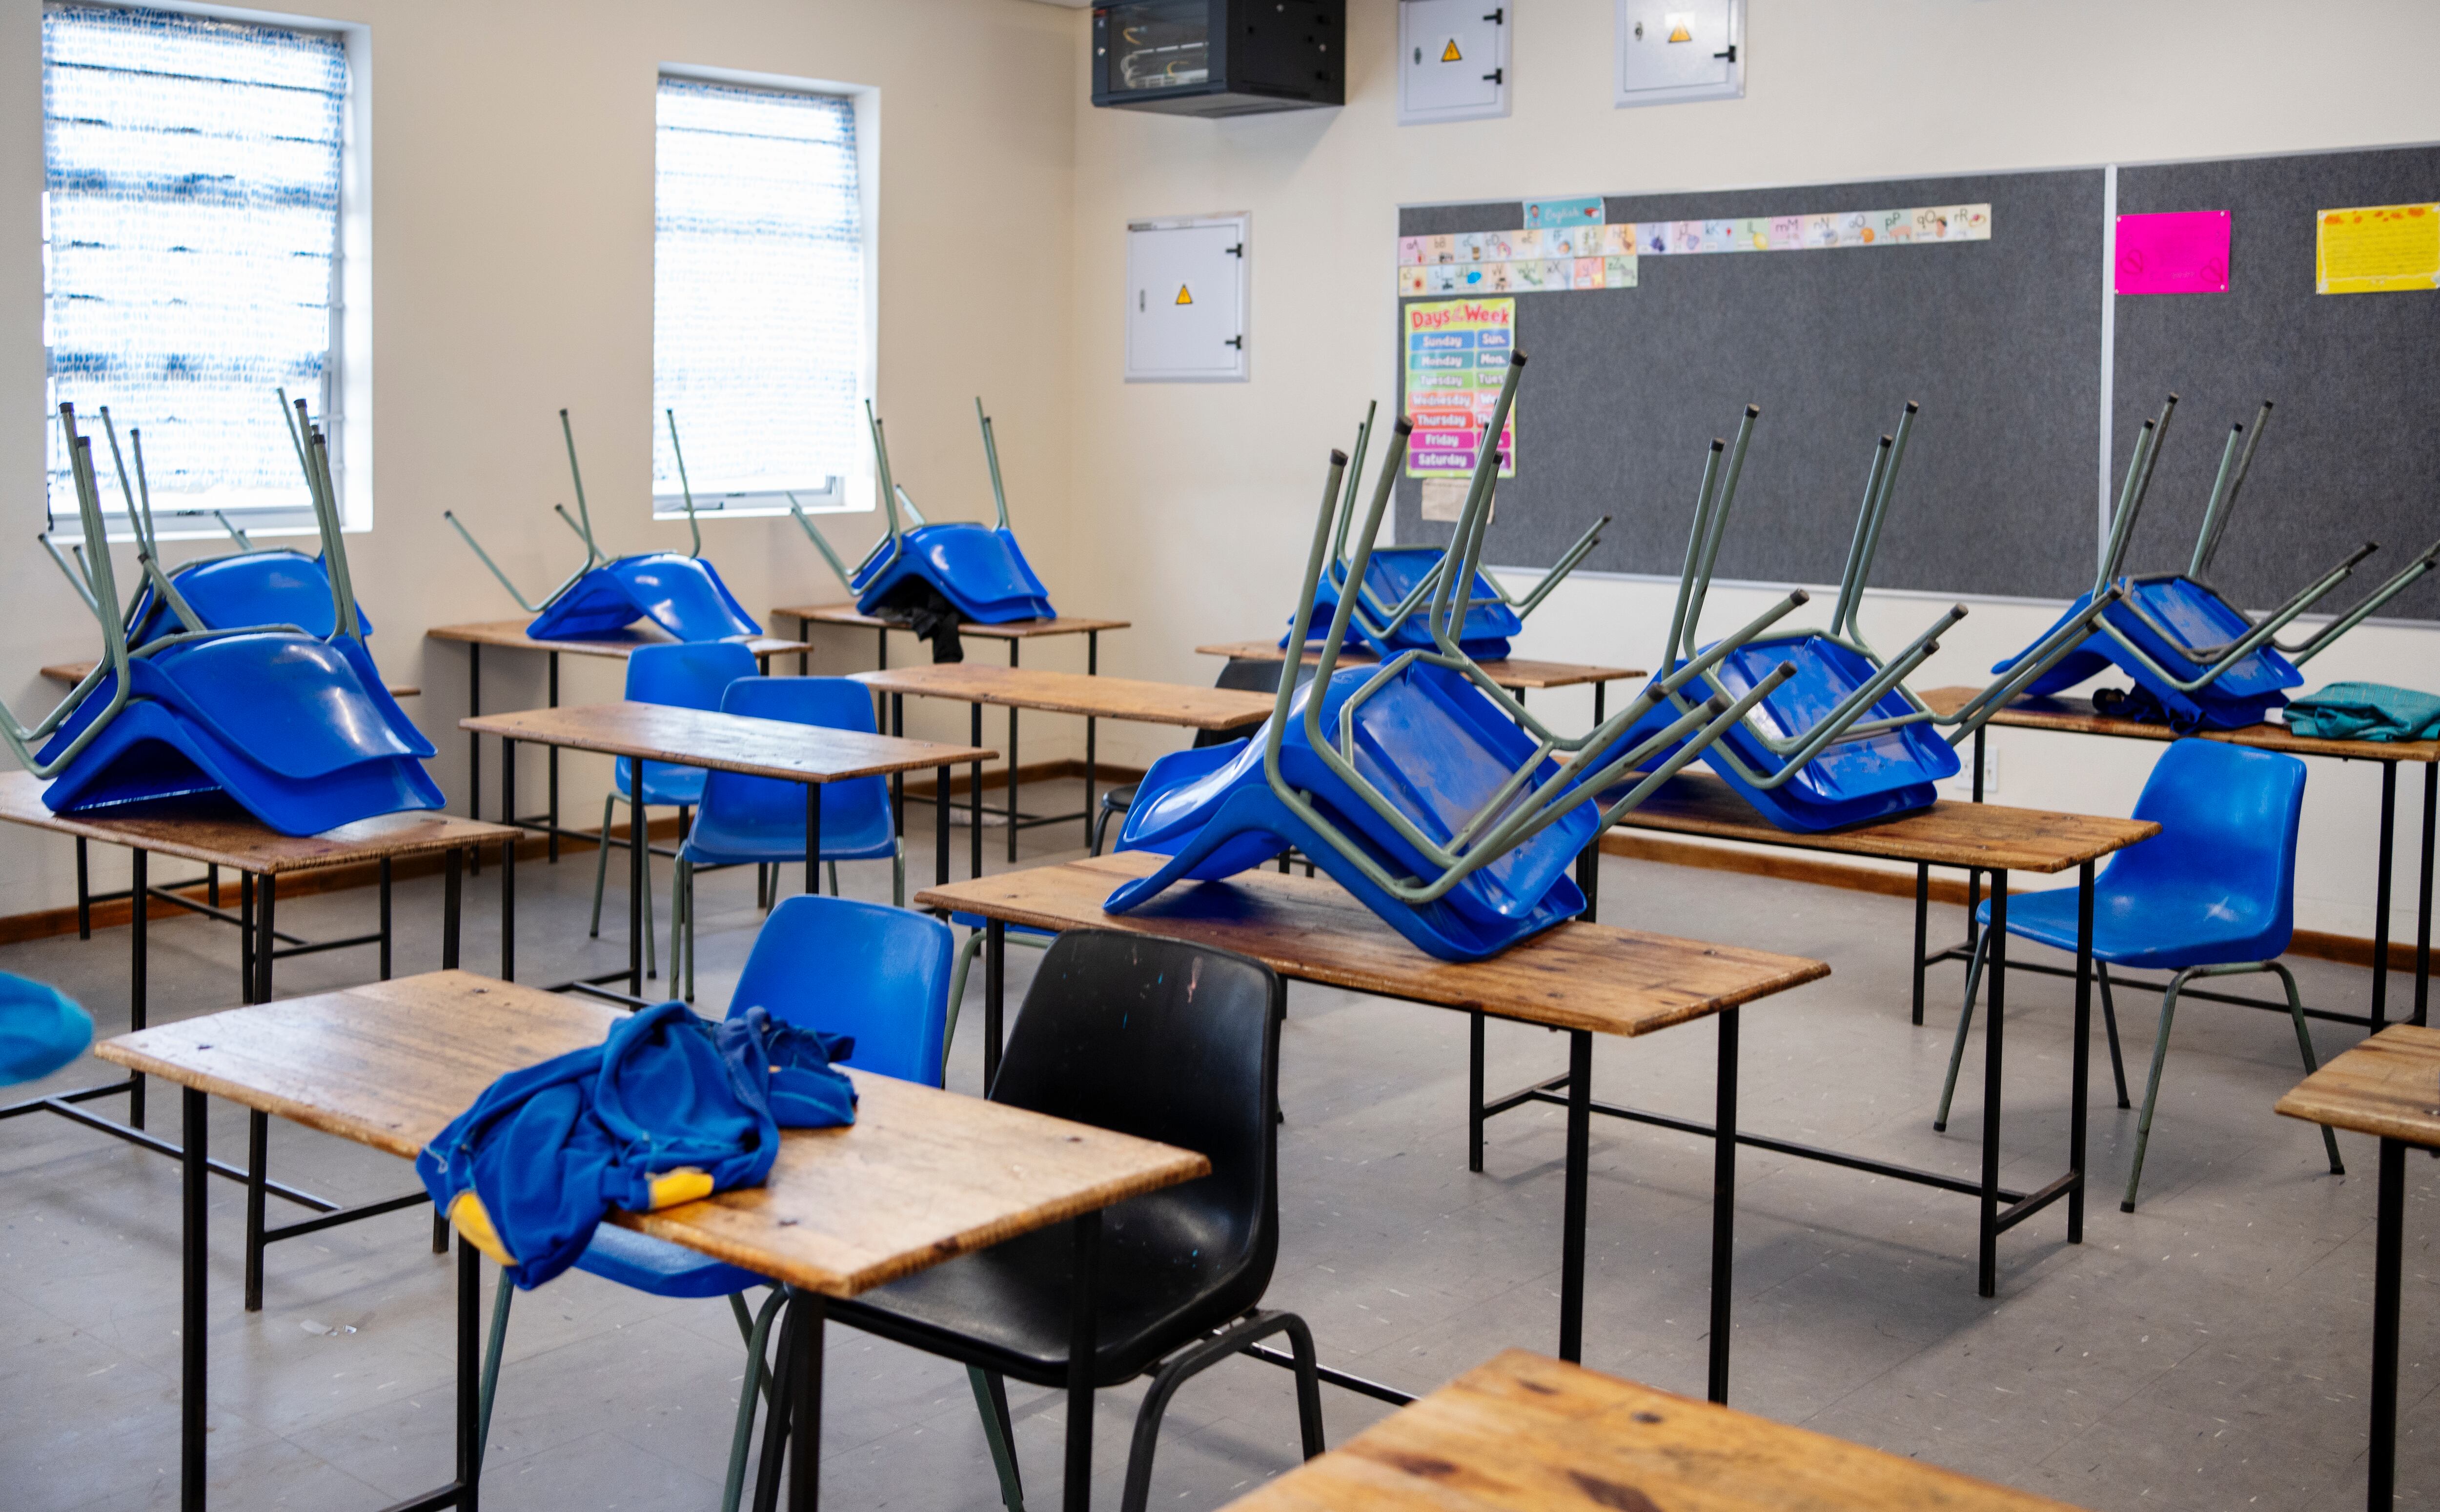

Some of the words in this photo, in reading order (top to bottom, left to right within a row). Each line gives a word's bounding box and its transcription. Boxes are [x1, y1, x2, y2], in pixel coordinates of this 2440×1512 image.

[1775, 218, 1799, 232] mM
[1411, 309, 1450, 329] Days
[1464, 304, 1509, 324] Week
[1423, 335, 1462, 348] Sunday
[1483, 333, 1505, 344] Sun.
[1421, 356, 1462, 368] Monday
[1420, 374, 1463, 387] Tuesday
[1413, 395, 1471, 407] Wednesday
[1417, 414, 1466, 427] Thursday
[1425, 434, 1459, 447] Friday
[1419, 453, 1467, 467] Saturday
